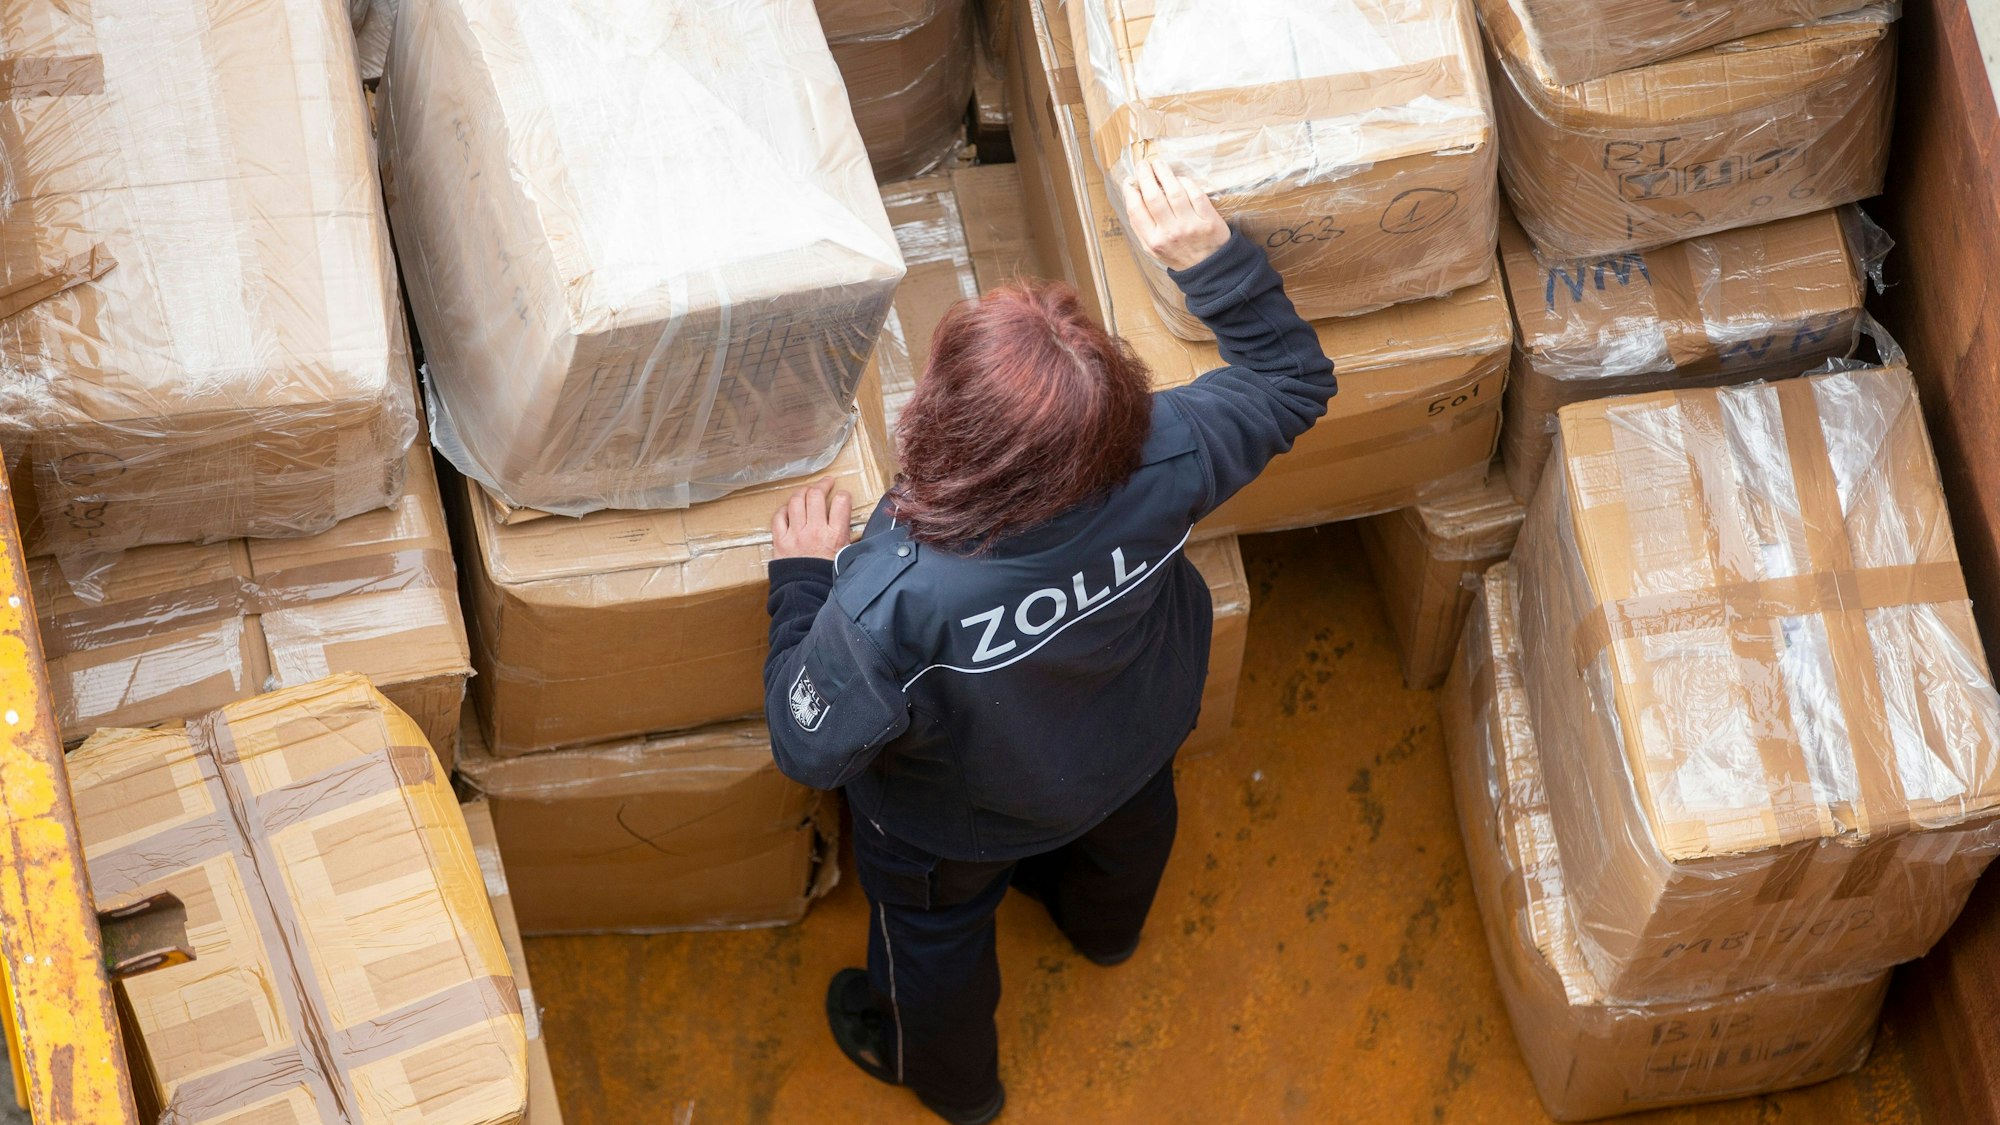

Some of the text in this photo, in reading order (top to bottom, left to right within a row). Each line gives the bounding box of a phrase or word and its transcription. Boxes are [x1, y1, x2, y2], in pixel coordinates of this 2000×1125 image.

[1267, 216, 1345, 247] 063
[1427, 383, 1480, 417] 501
[960, 546, 1148, 663] ZOLL
[803, 675, 821, 707] ZOLL
